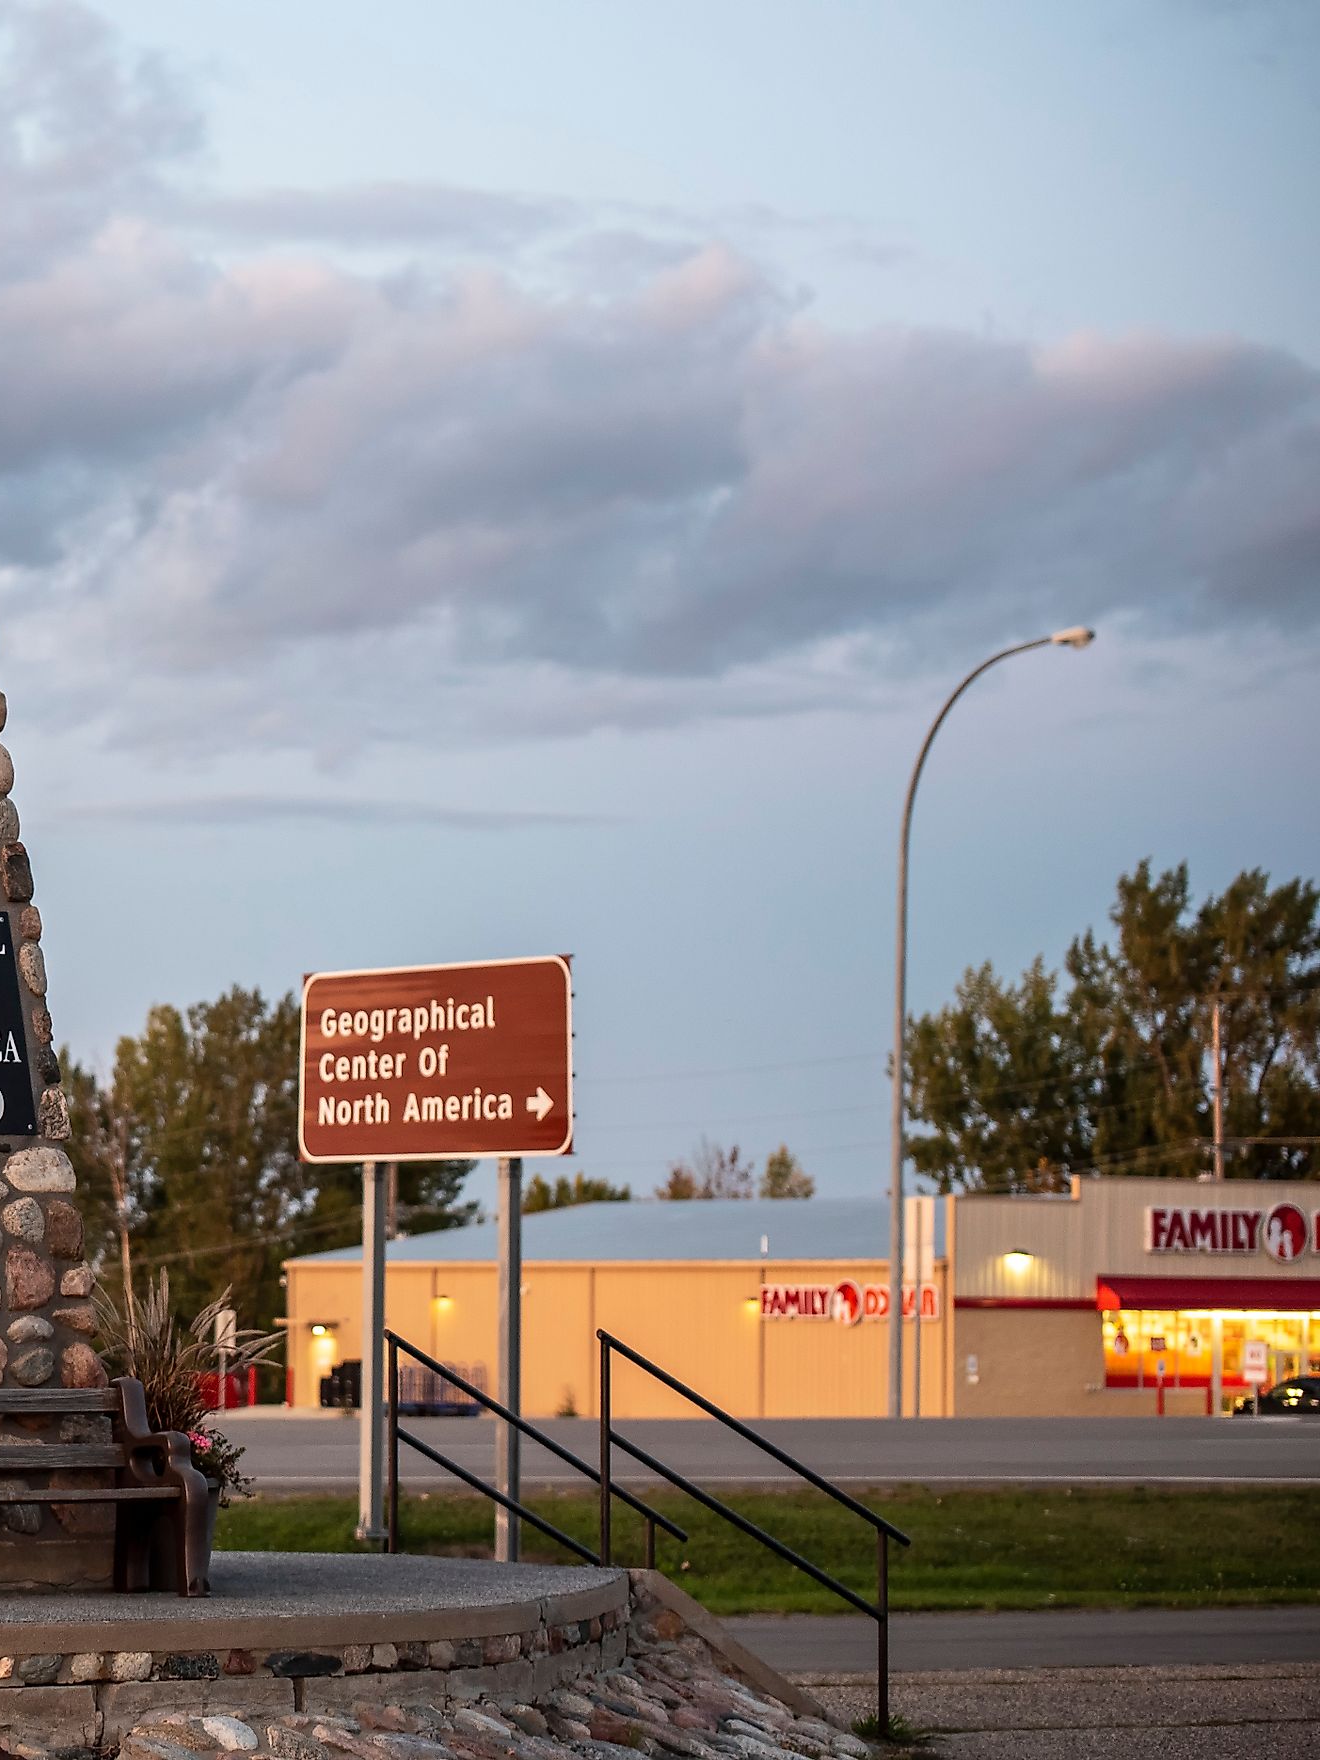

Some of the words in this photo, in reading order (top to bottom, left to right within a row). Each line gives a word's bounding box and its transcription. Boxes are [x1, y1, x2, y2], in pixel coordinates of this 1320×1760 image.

[320, 995, 496, 1043] Geographical
[318, 1049, 407, 1083] Center
[418, 1043, 450, 1078] Of
[317, 1091, 390, 1127] North
[402, 1087, 513, 1123] America
[1152, 1208, 1261, 1250] FAMILY
[761, 1289, 829, 1316] FAMILY
